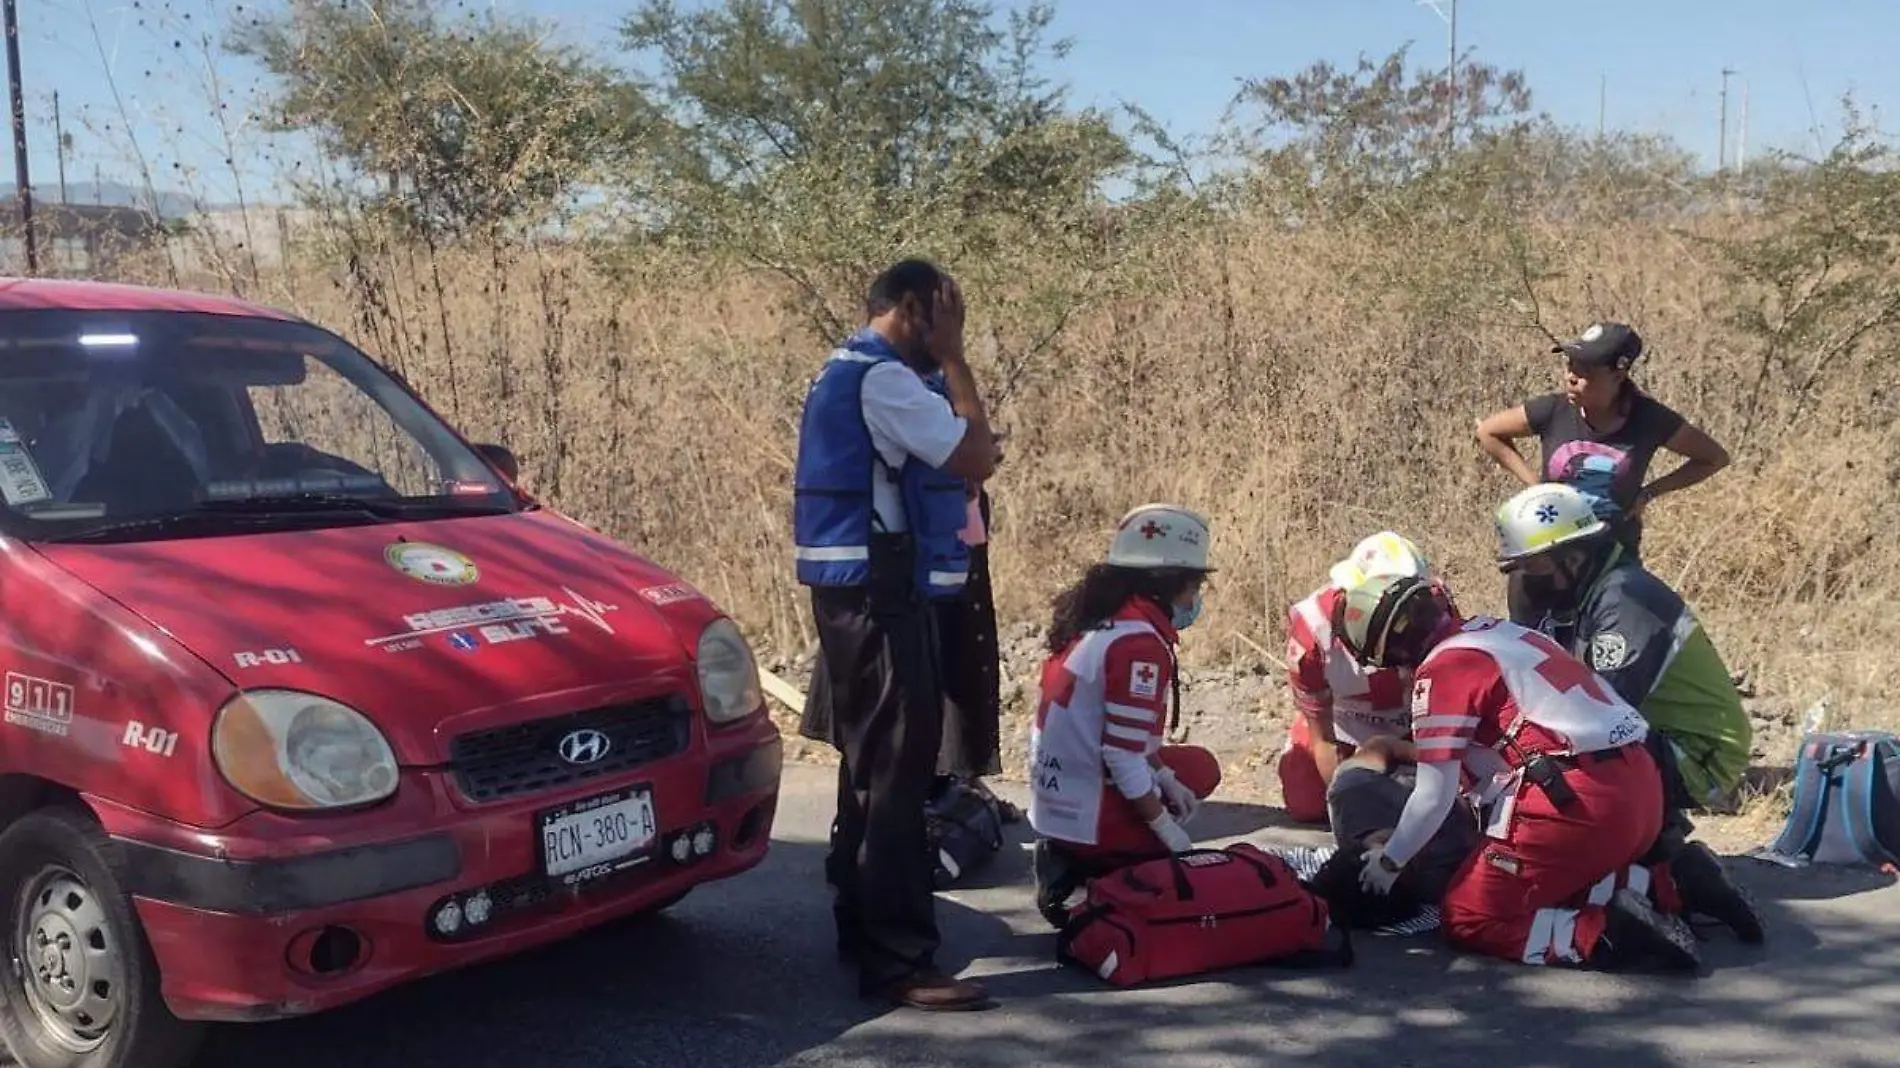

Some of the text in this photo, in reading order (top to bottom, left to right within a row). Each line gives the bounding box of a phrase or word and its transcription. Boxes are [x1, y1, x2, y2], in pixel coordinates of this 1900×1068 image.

[233, 648, 302, 668] R-01
[10, 681, 66, 717] 911
[122, 719, 178, 757] R-01
[546, 803, 654, 865] RCN-380-A
